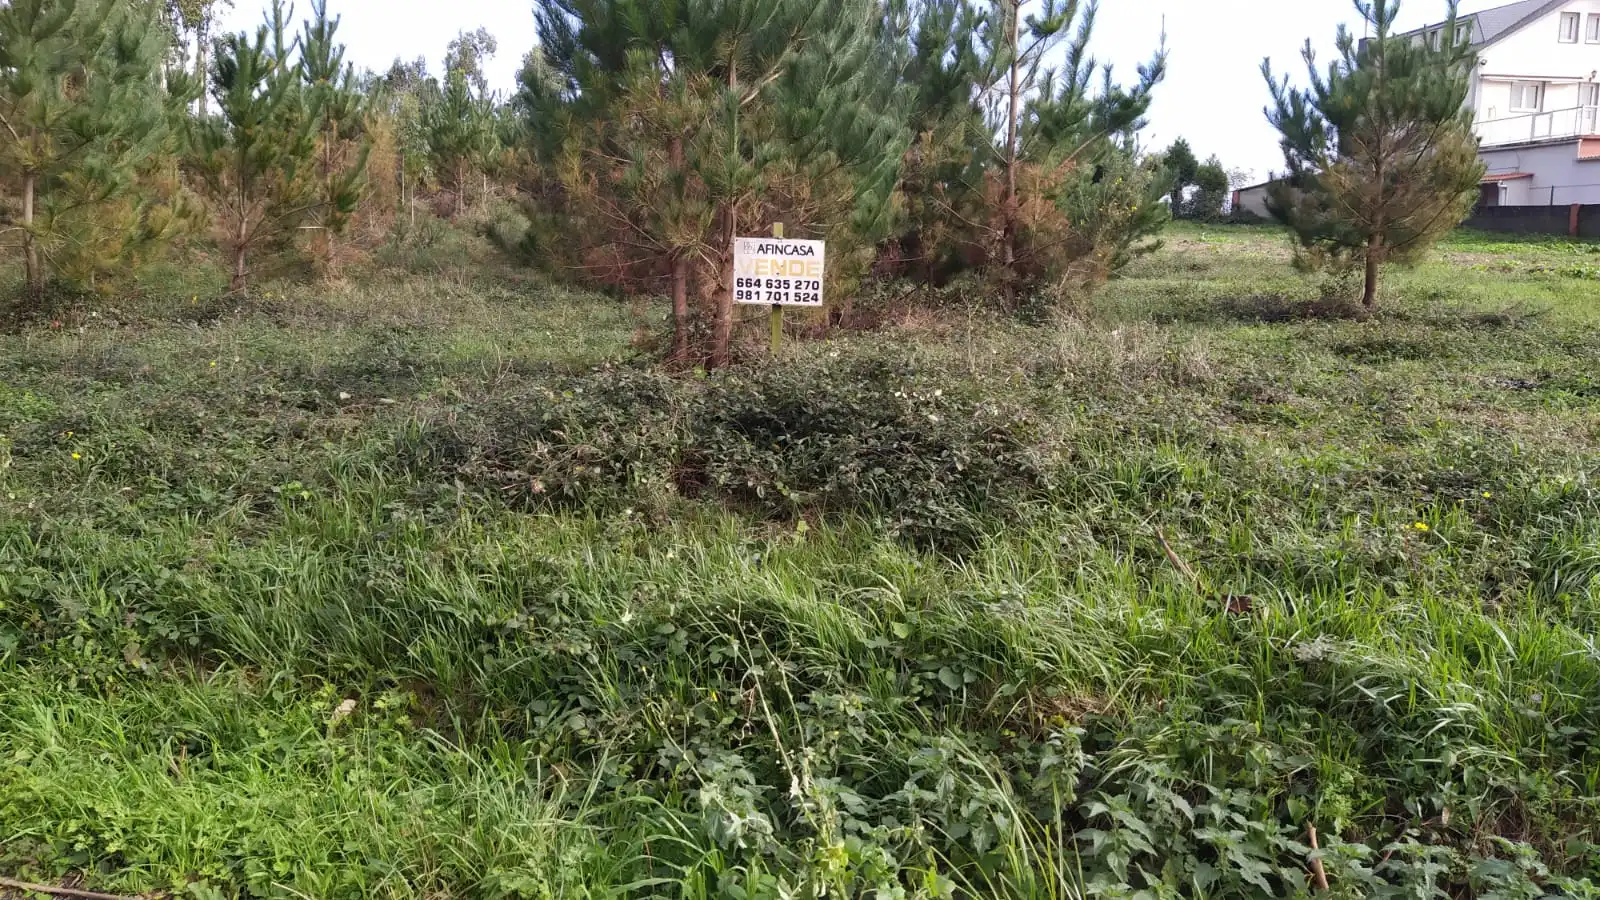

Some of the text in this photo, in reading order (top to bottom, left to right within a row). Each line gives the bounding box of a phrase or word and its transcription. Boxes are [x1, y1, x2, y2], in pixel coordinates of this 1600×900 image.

[757, 243, 814, 256] AFINCASA
[739, 259, 819, 276] VENDE
[736, 278, 819, 290] 664 635 270
[736, 290, 819, 302] 981 701 524
